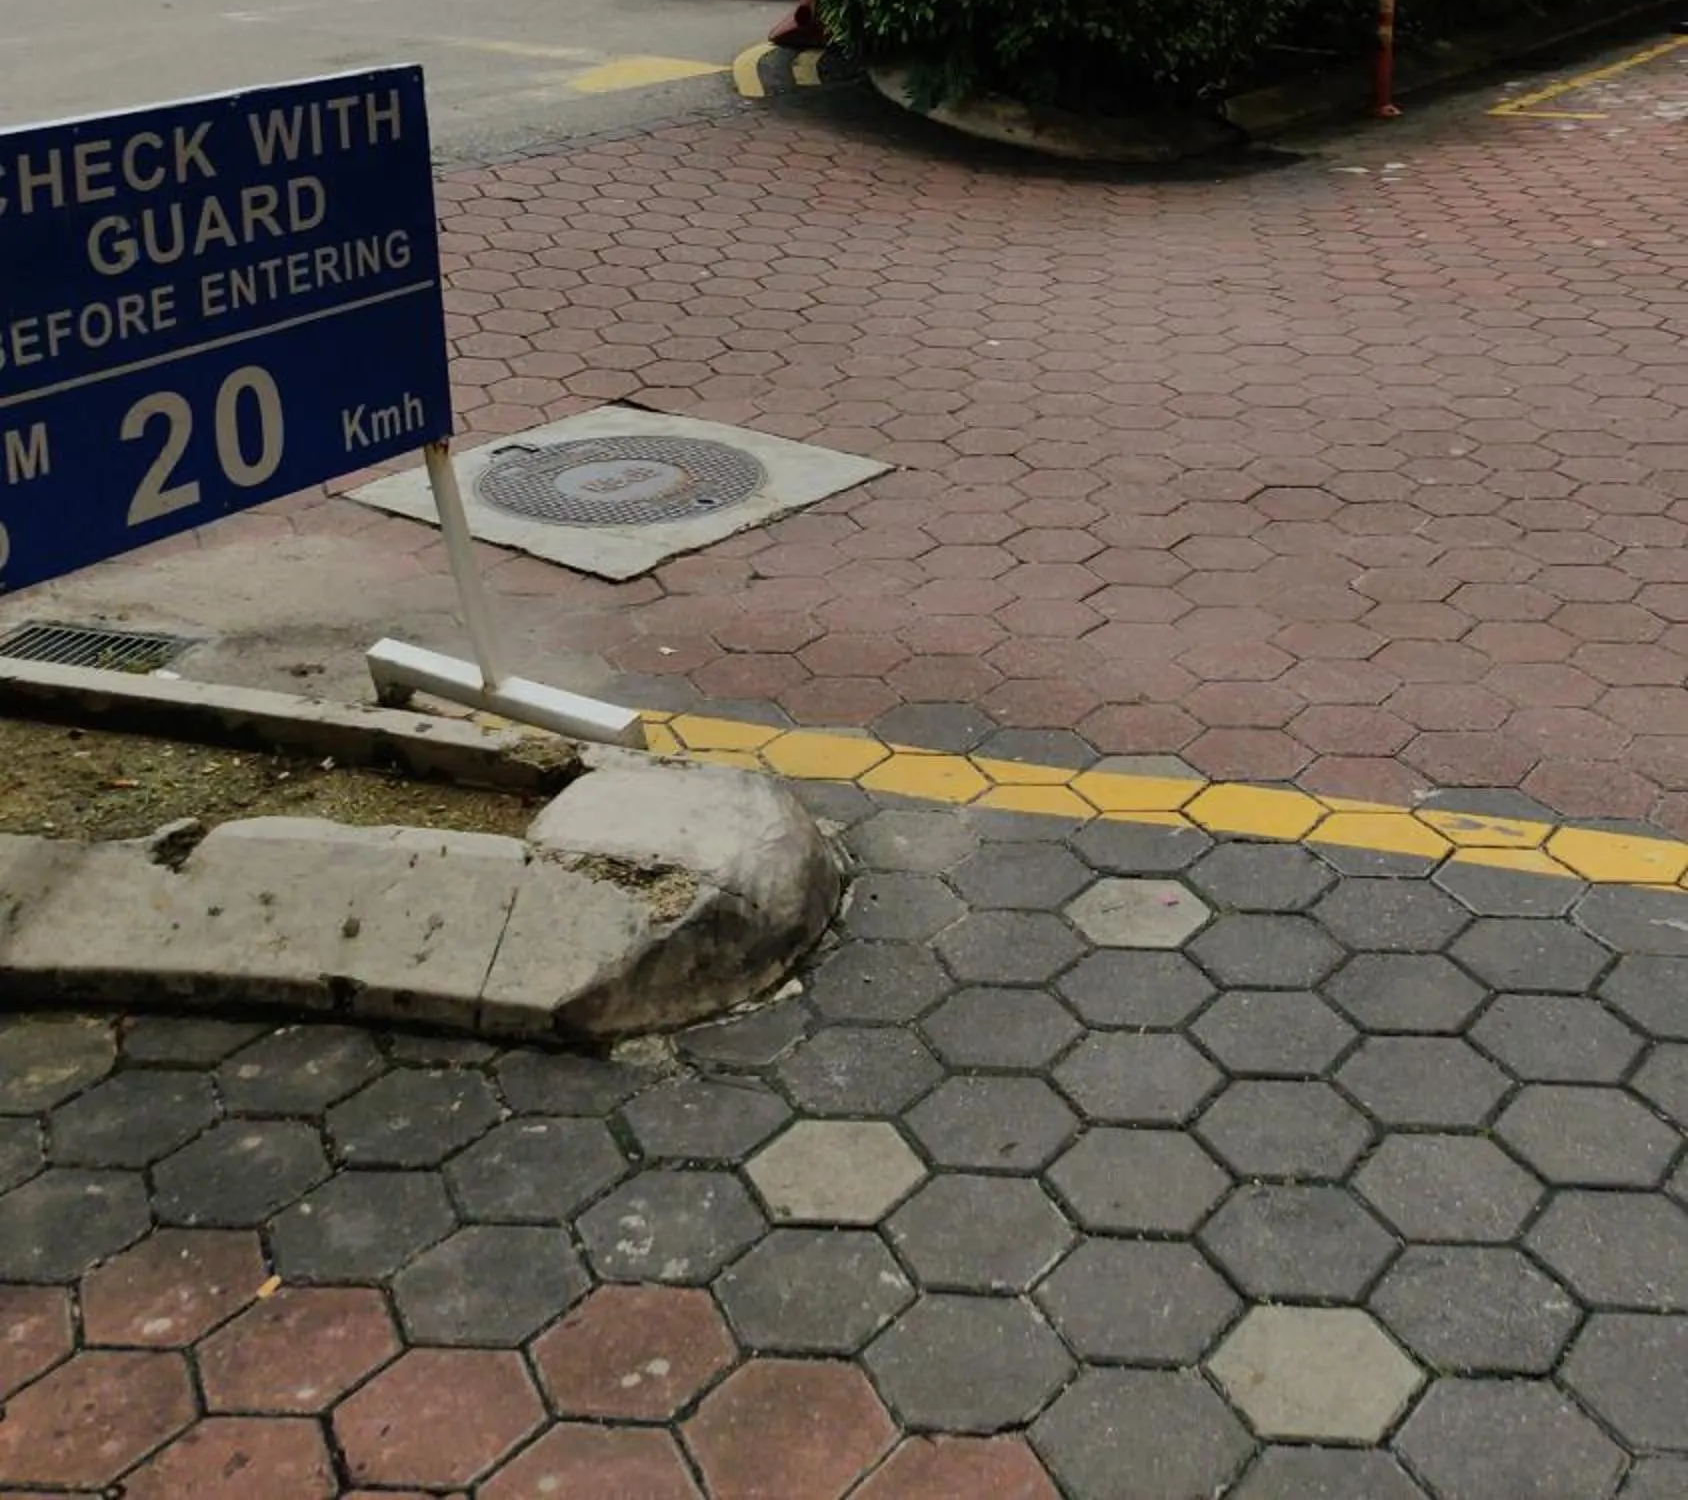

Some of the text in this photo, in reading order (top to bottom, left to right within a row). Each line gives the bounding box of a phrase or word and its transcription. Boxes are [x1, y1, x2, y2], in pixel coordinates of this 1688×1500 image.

[249, 90, 400, 166] WITH
[88, 176, 326, 275] GUARD
[0, 230, 411, 371] EFORE ENTERING
[120, 365, 285, 527] 20
[342, 392, 425, 453] Kmh
